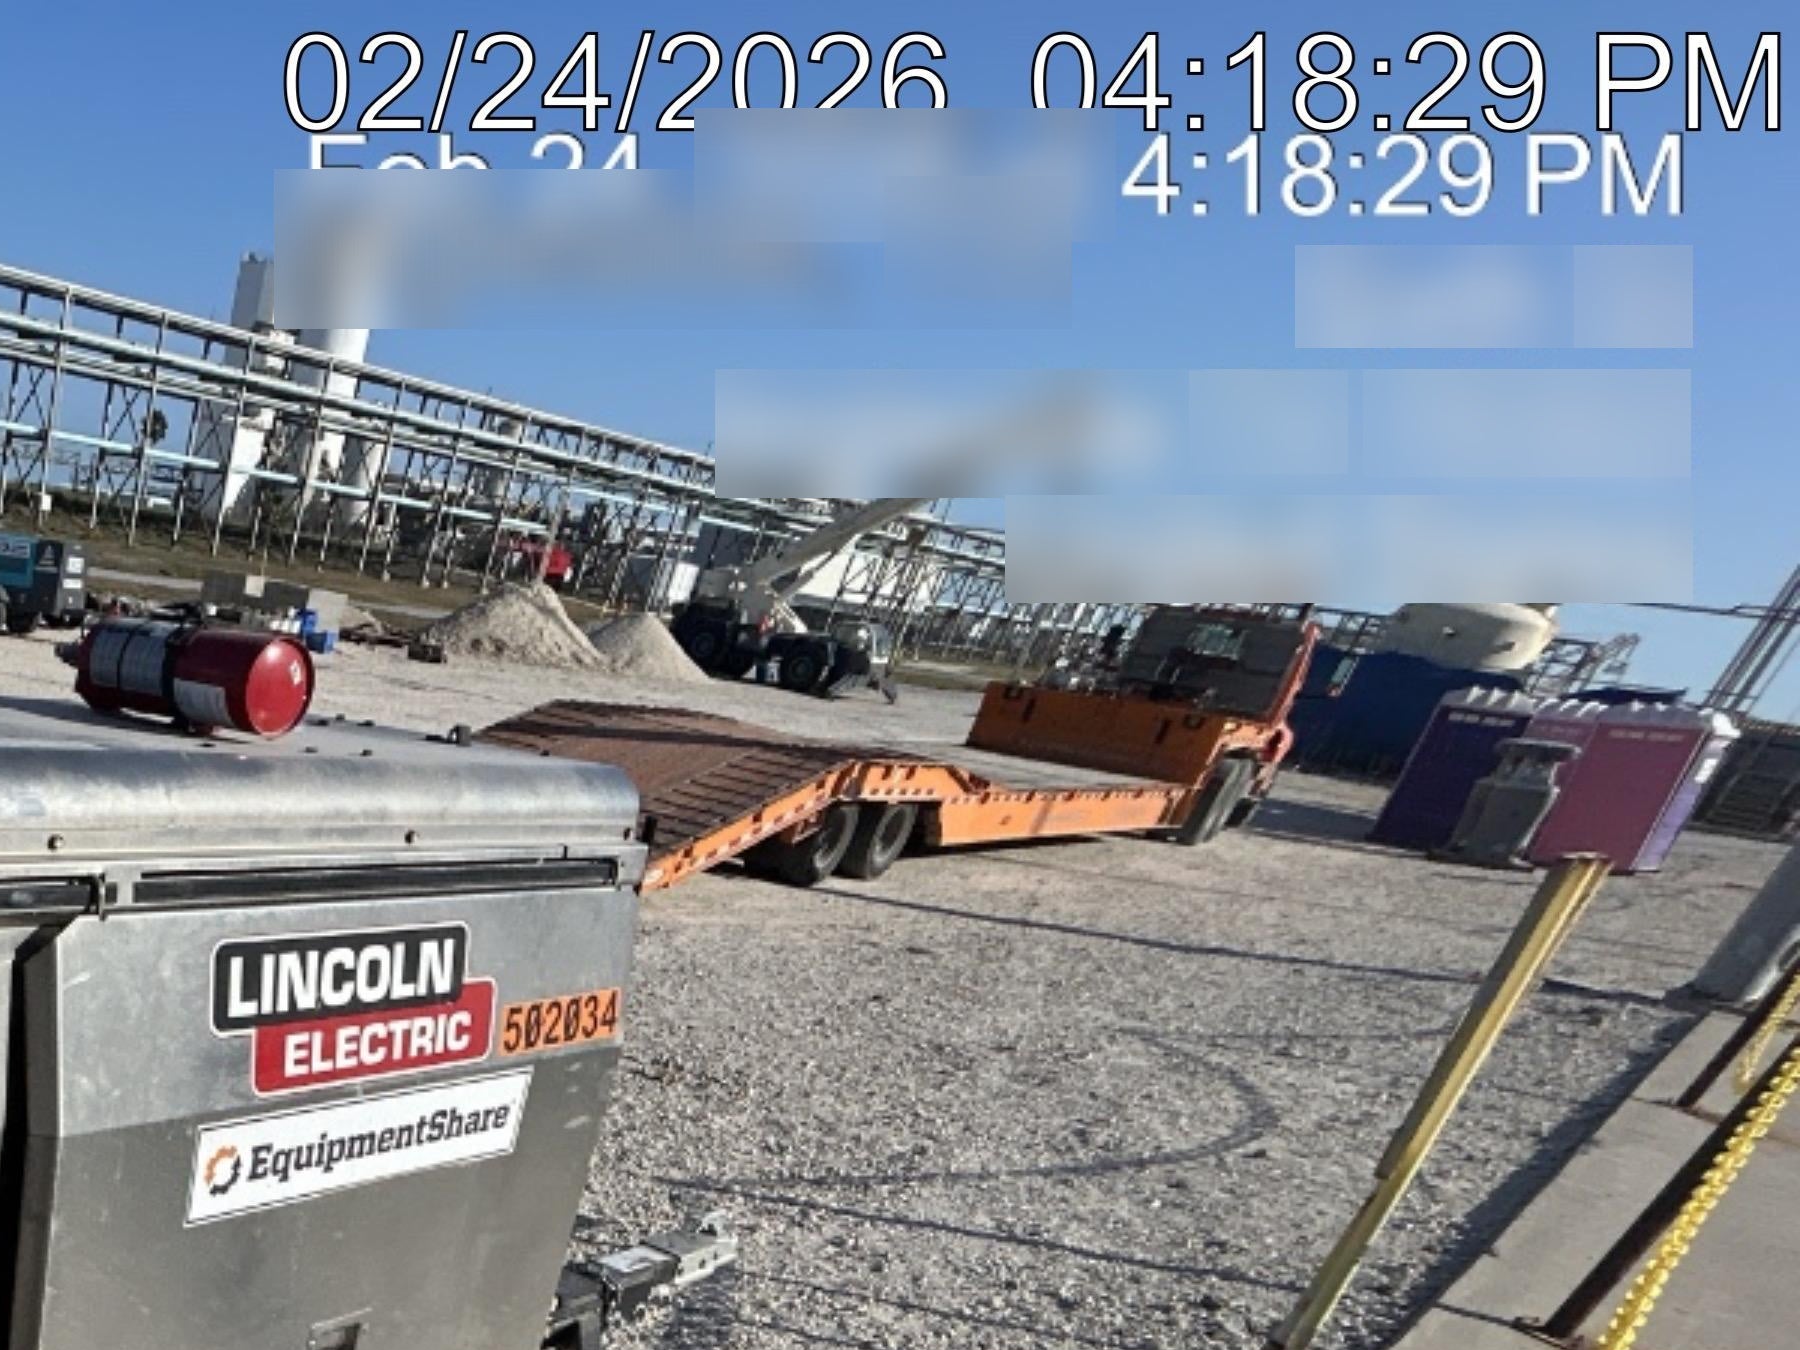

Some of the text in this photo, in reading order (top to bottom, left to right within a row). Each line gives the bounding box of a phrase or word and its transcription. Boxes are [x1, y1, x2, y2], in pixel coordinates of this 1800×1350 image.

[227, 938, 456, 1018] LINCOLN
[283, 1009, 473, 1079] ELECTRIC
[502, 991, 619, 1055] 502034
[246, 1102, 510, 1184] EquipmentShare
